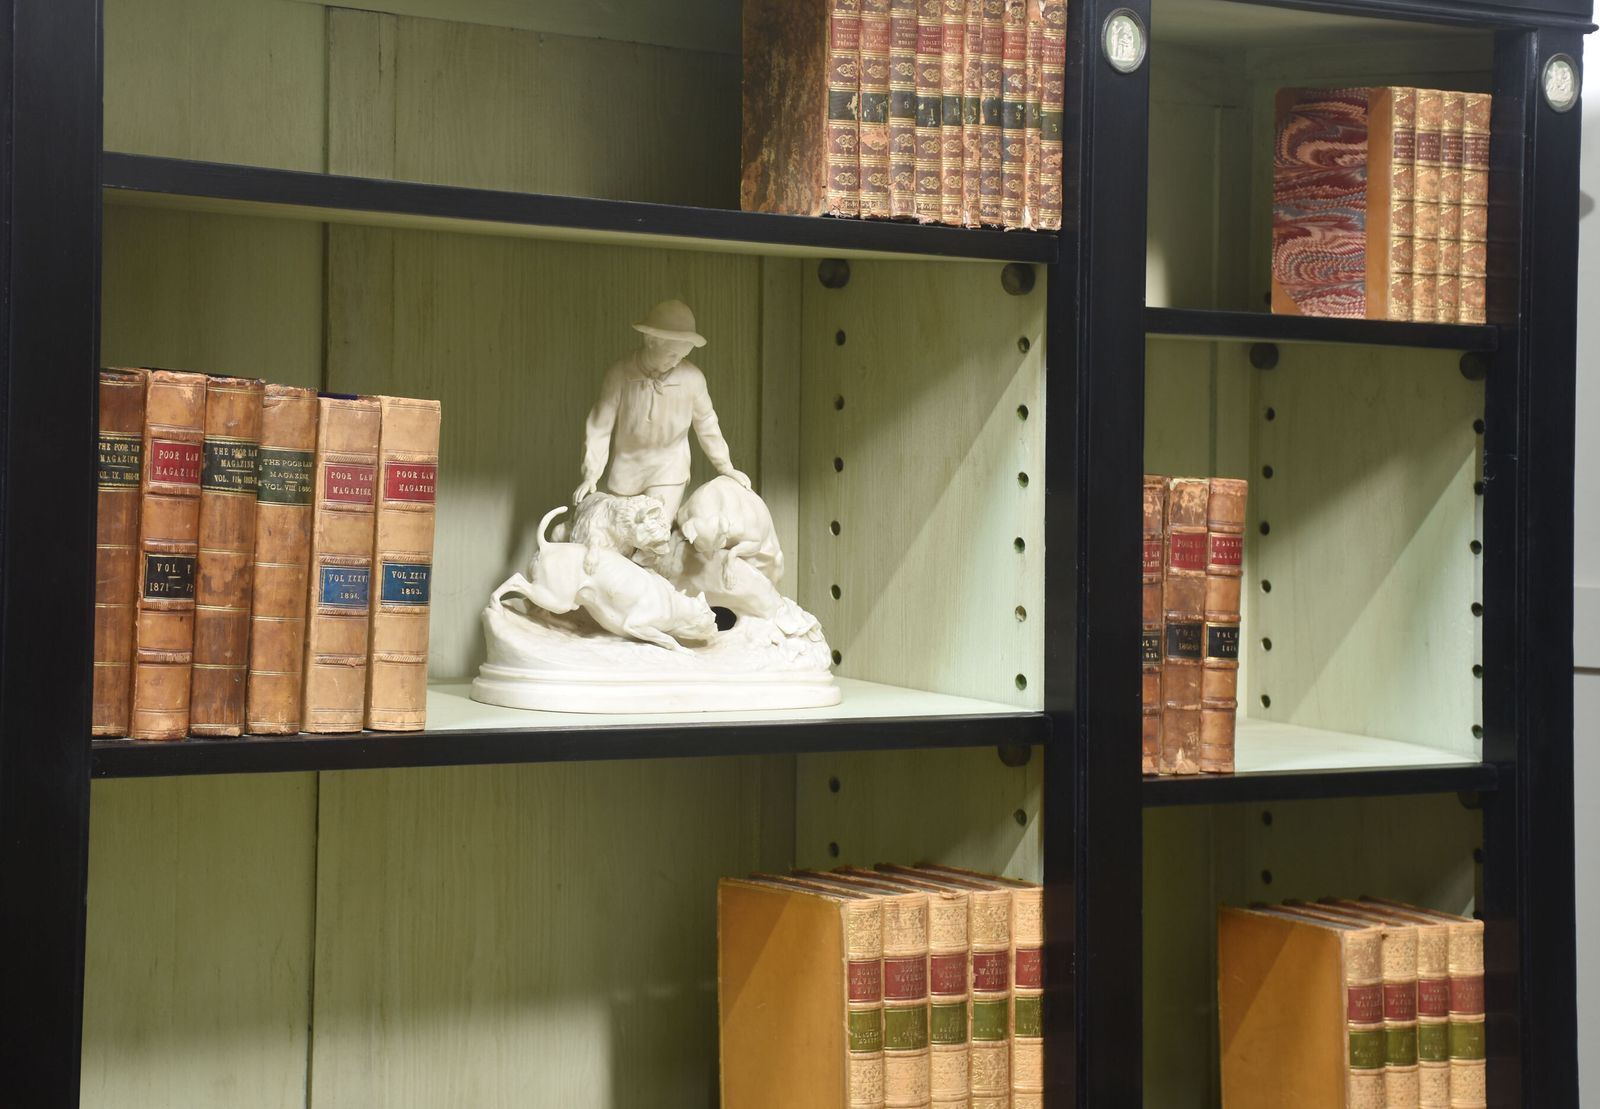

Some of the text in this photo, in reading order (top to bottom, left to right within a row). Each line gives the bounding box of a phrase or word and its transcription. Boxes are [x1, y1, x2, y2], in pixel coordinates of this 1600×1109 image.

[114, 443, 129, 451] POOR
[213, 447, 229, 456] THE
[100, 454, 139, 464] MAGAZINE
[158, 449, 180, 460] POOR
[220, 459, 254, 468] MAGAZINE
[262, 458, 281, 466] THE
[282, 459, 303, 467] POOR
[331, 471, 352, 480] POOR
[396, 470, 418, 479] POOR
[149, 582, 169, 592] 1871
